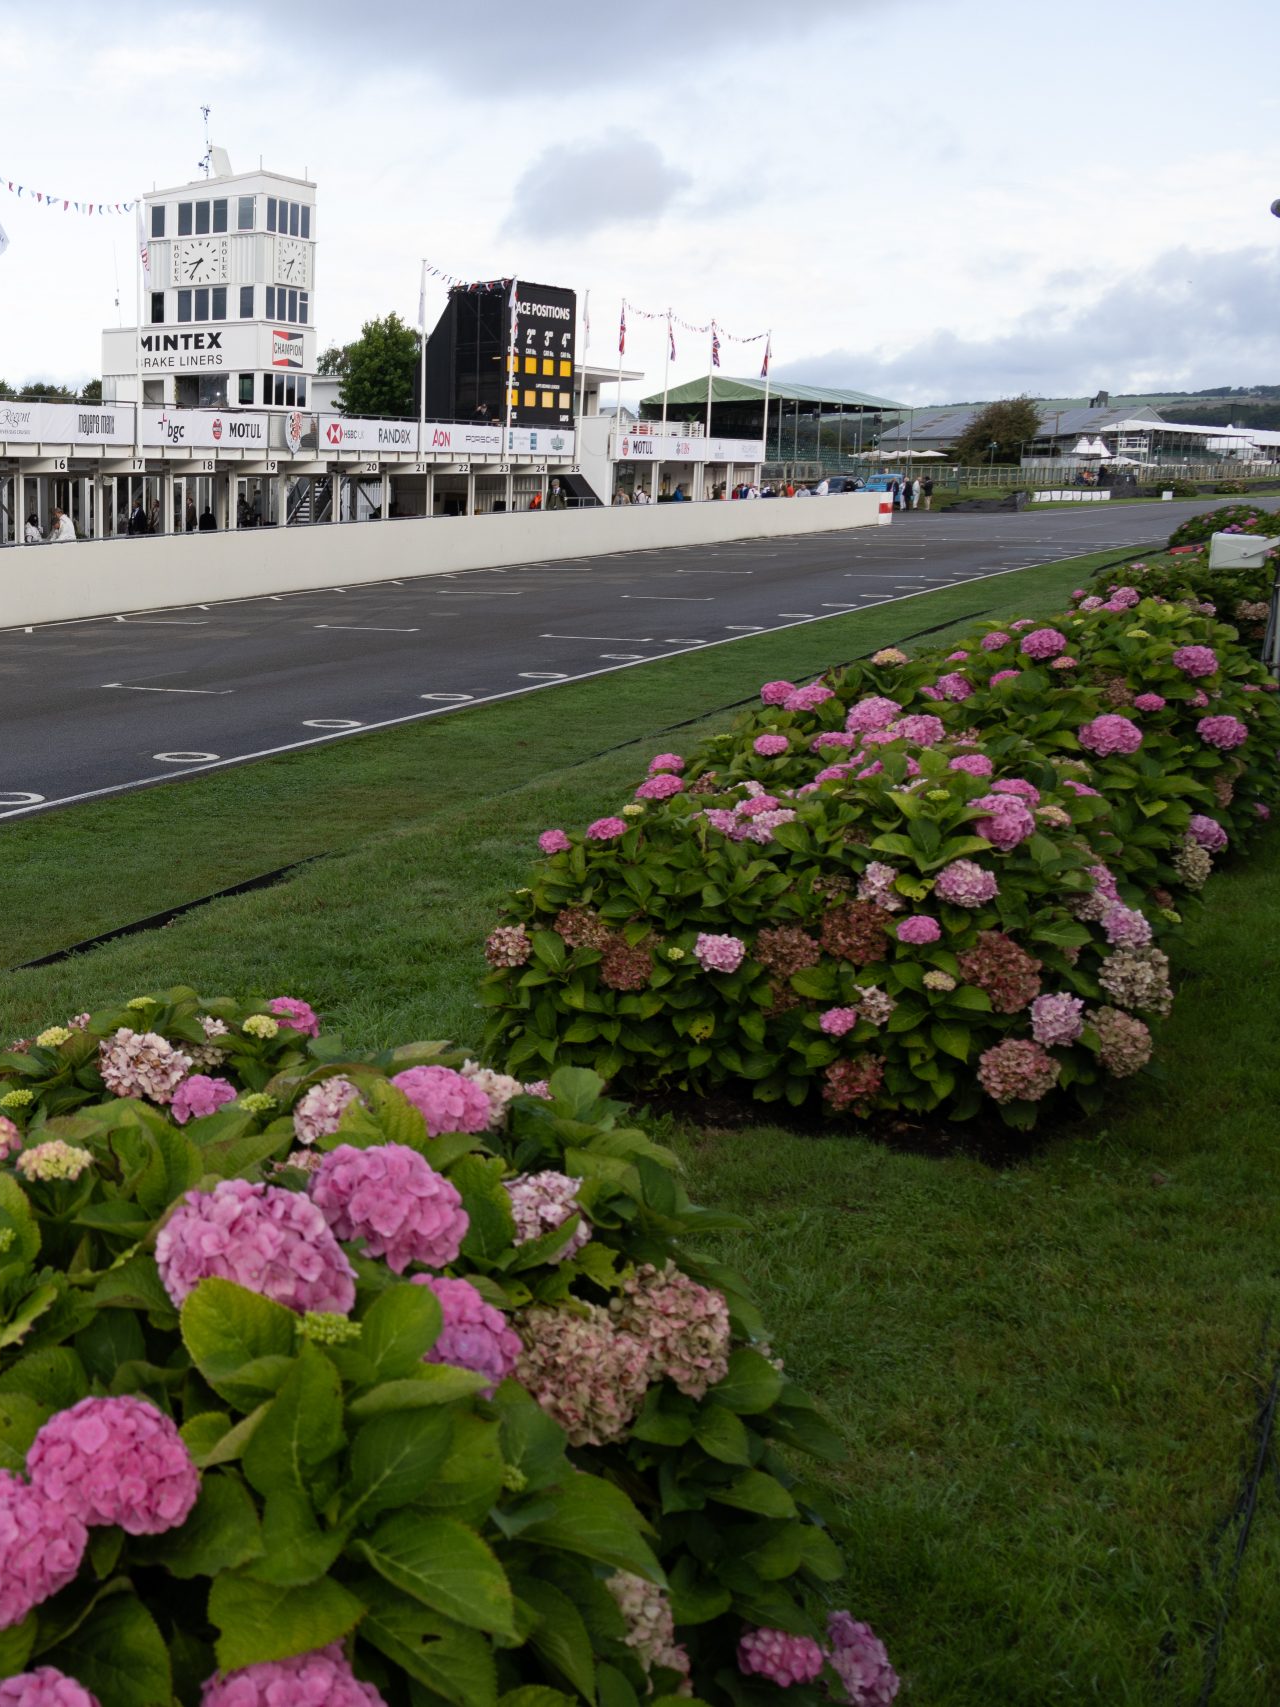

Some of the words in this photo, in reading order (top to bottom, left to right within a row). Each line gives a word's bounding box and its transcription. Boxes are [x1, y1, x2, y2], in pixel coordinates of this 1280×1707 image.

[531, 303, 570, 320] POSITIONS
[140, 331, 223, 352] MINTEX
[273, 341, 303, 357] CHAMPION
[141, 356, 175, 368] RAKE
[179, 354, 223, 366] LINERS
[167, 420, 185, 443] bgc
[229, 422, 262, 439] MOTUL
[343, 429, 358, 439] HSBC
[378, 428, 412, 444] RANDOX
[432, 428, 451, 447] AON
[465, 435, 500, 444] PORSCHE
[632, 440, 653, 454] MOTUL
[54, 459, 66, 470] 16
[132, 459, 143, 470] 17
[202, 460, 213, 470] 18
[265, 461, 276, 471] 19
[366, 462, 378, 472] 20
[415, 463, 426, 472] 21
[458, 464, 469, 472] 22
[499, 464, 509, 473] 23
[535, 465, 546, 473] 24
[570, 465, 580, 473] 25
